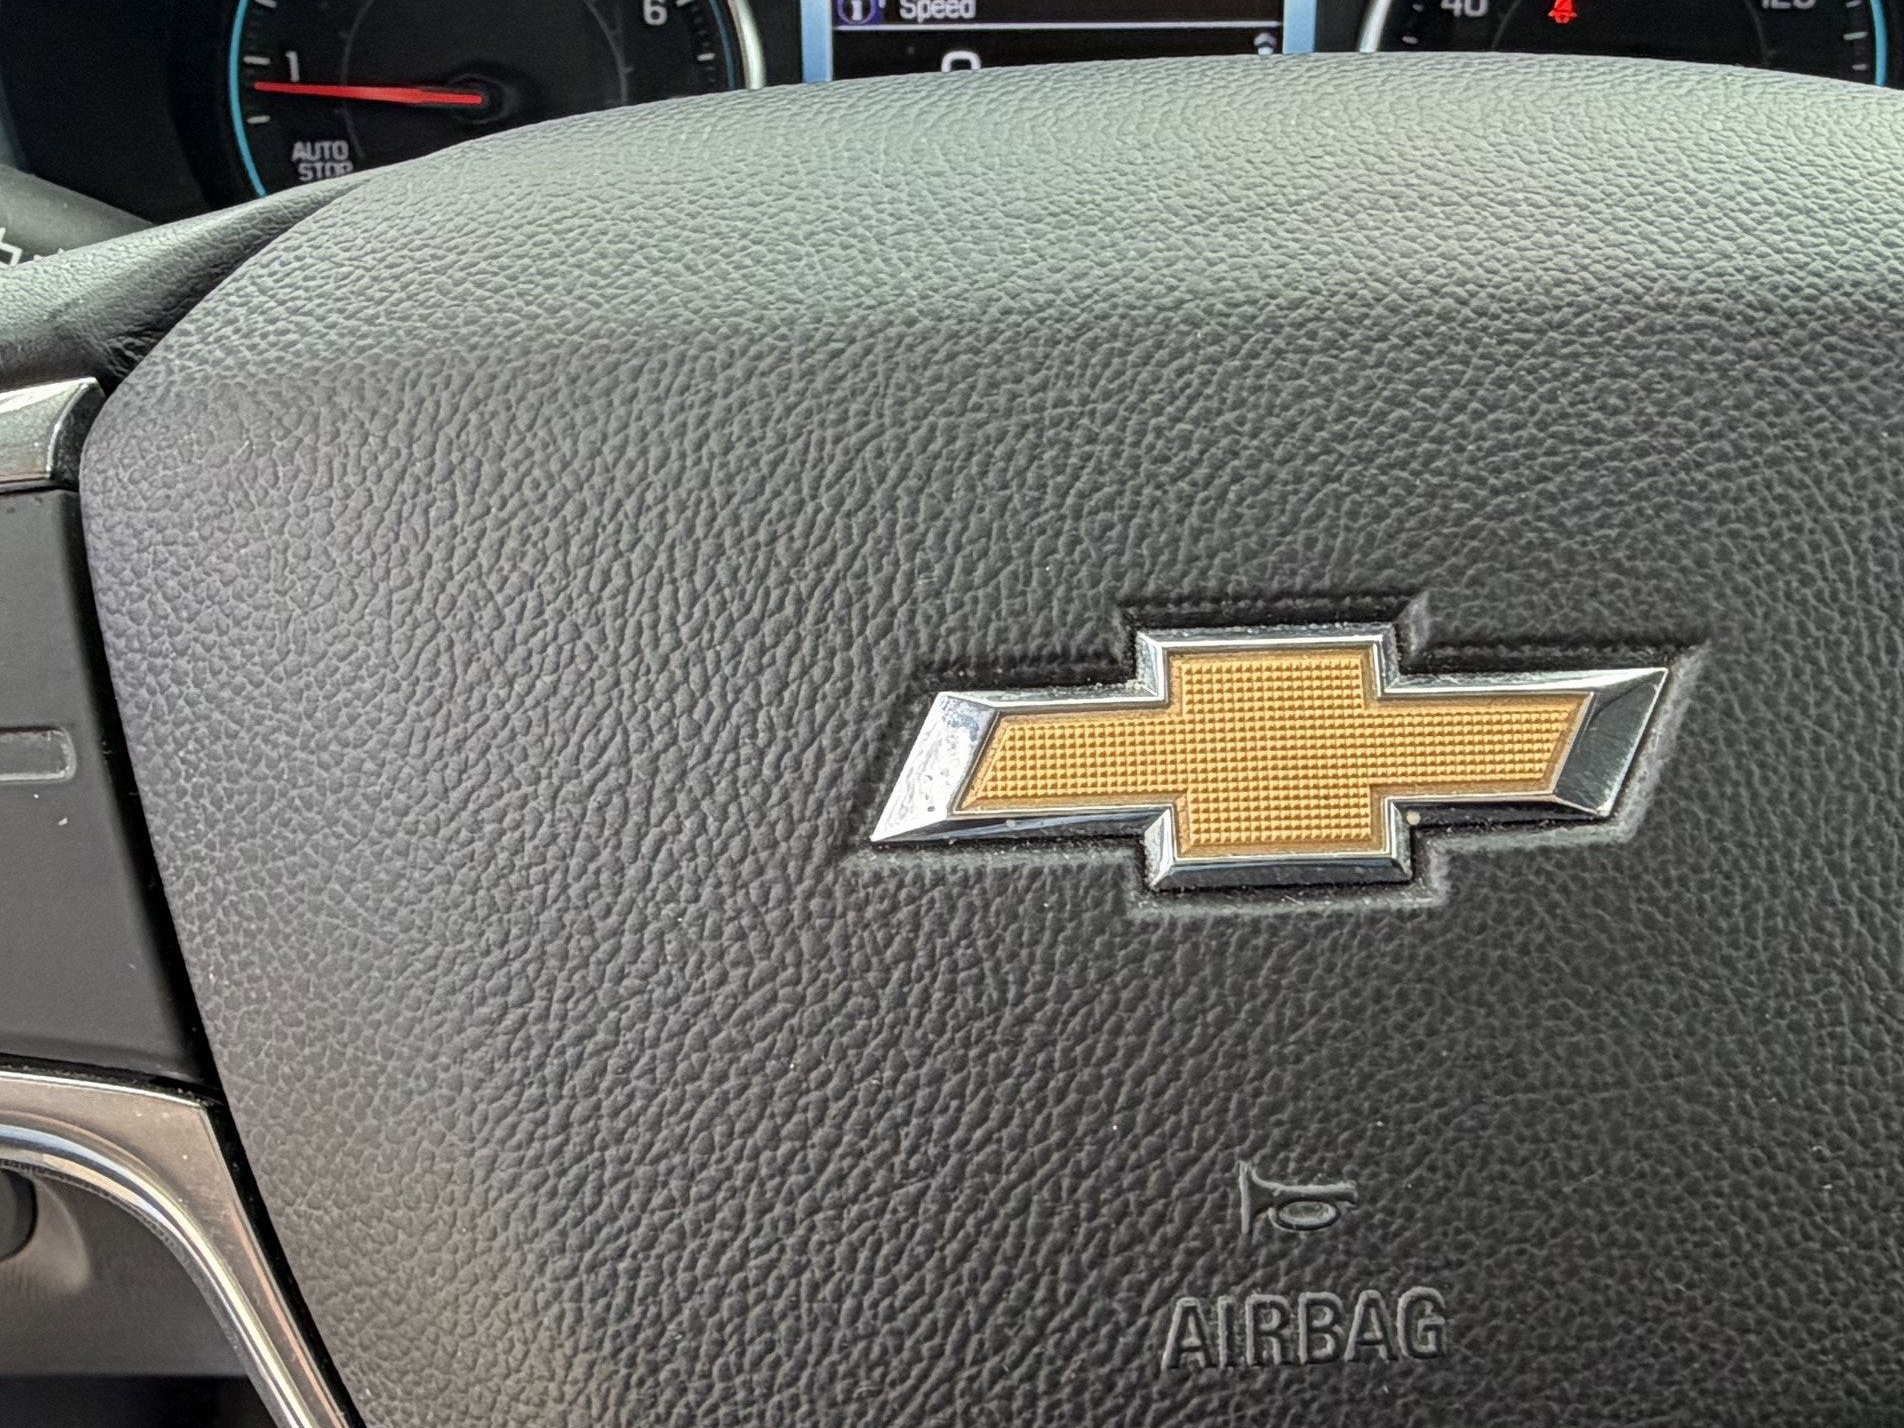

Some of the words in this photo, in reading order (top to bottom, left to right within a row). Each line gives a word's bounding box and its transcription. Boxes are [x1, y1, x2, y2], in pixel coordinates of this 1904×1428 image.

[285, 51, 299, 81] 1
[292, 141, 349, 162] AUTO
[298, 162, 353, 181] STOP
[1161, 1286, 1447, 1372] AIRBAG
